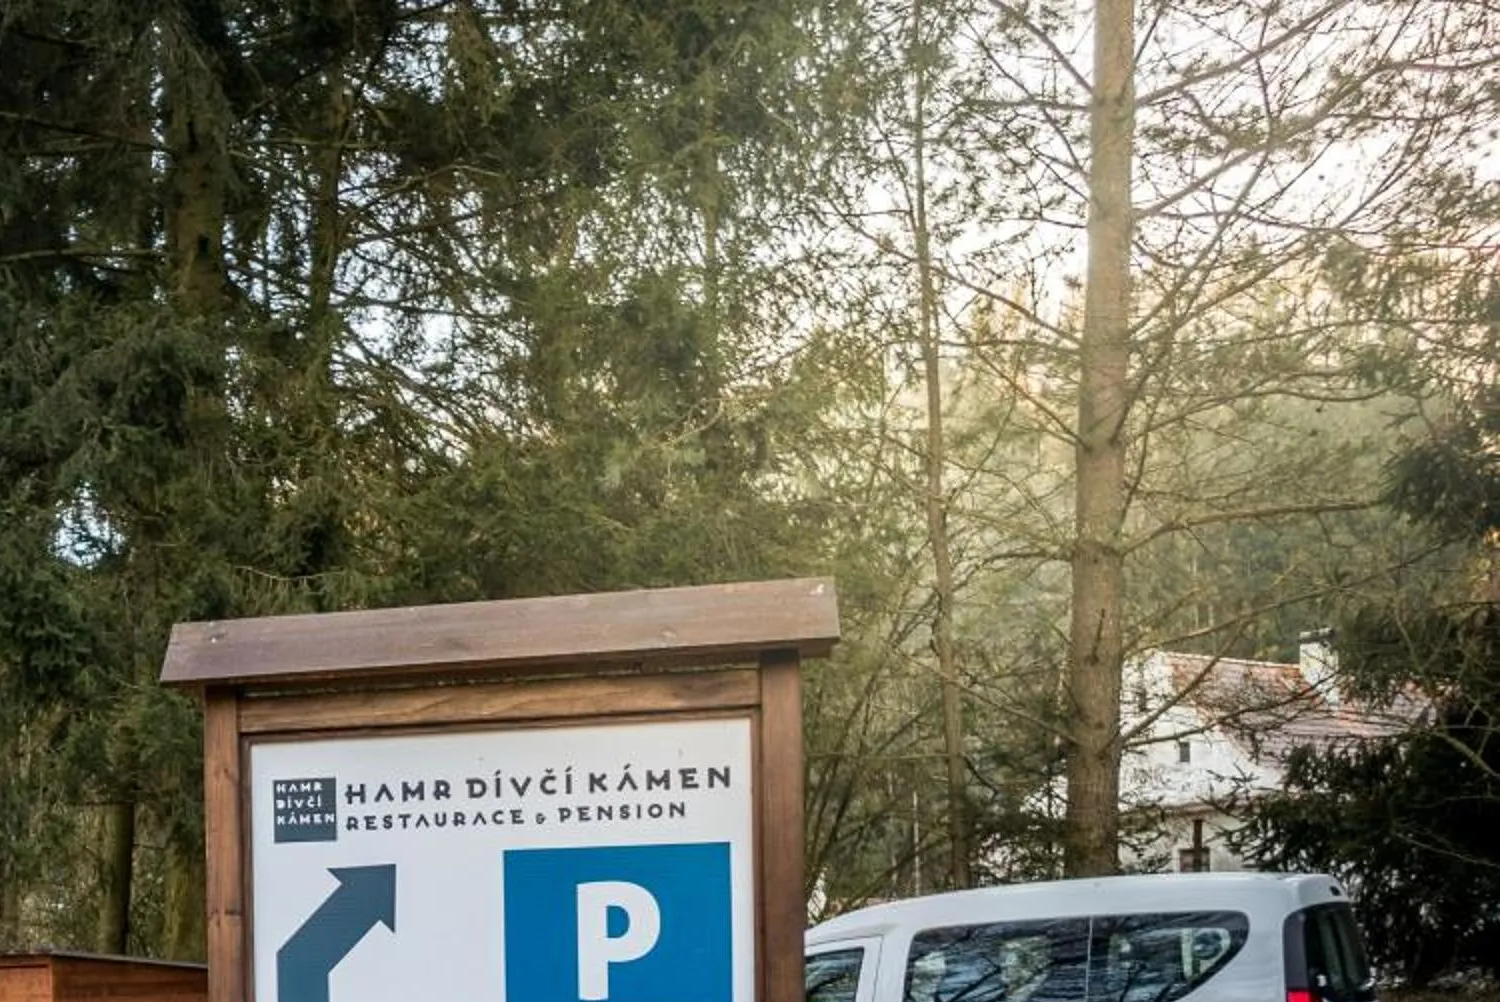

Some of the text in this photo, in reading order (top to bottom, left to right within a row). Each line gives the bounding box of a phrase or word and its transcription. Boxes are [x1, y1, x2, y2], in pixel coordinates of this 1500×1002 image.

[276, 781, 322, 793] HAMR
[344, 763, 731, 805] HAMR DÍVČÍ KÁMEN
[276, 811, 335, 826] KÁMEN
[345, 801, 685, 831] RESTAURACE & PENSION
[576, 880, 661, 1001] P
